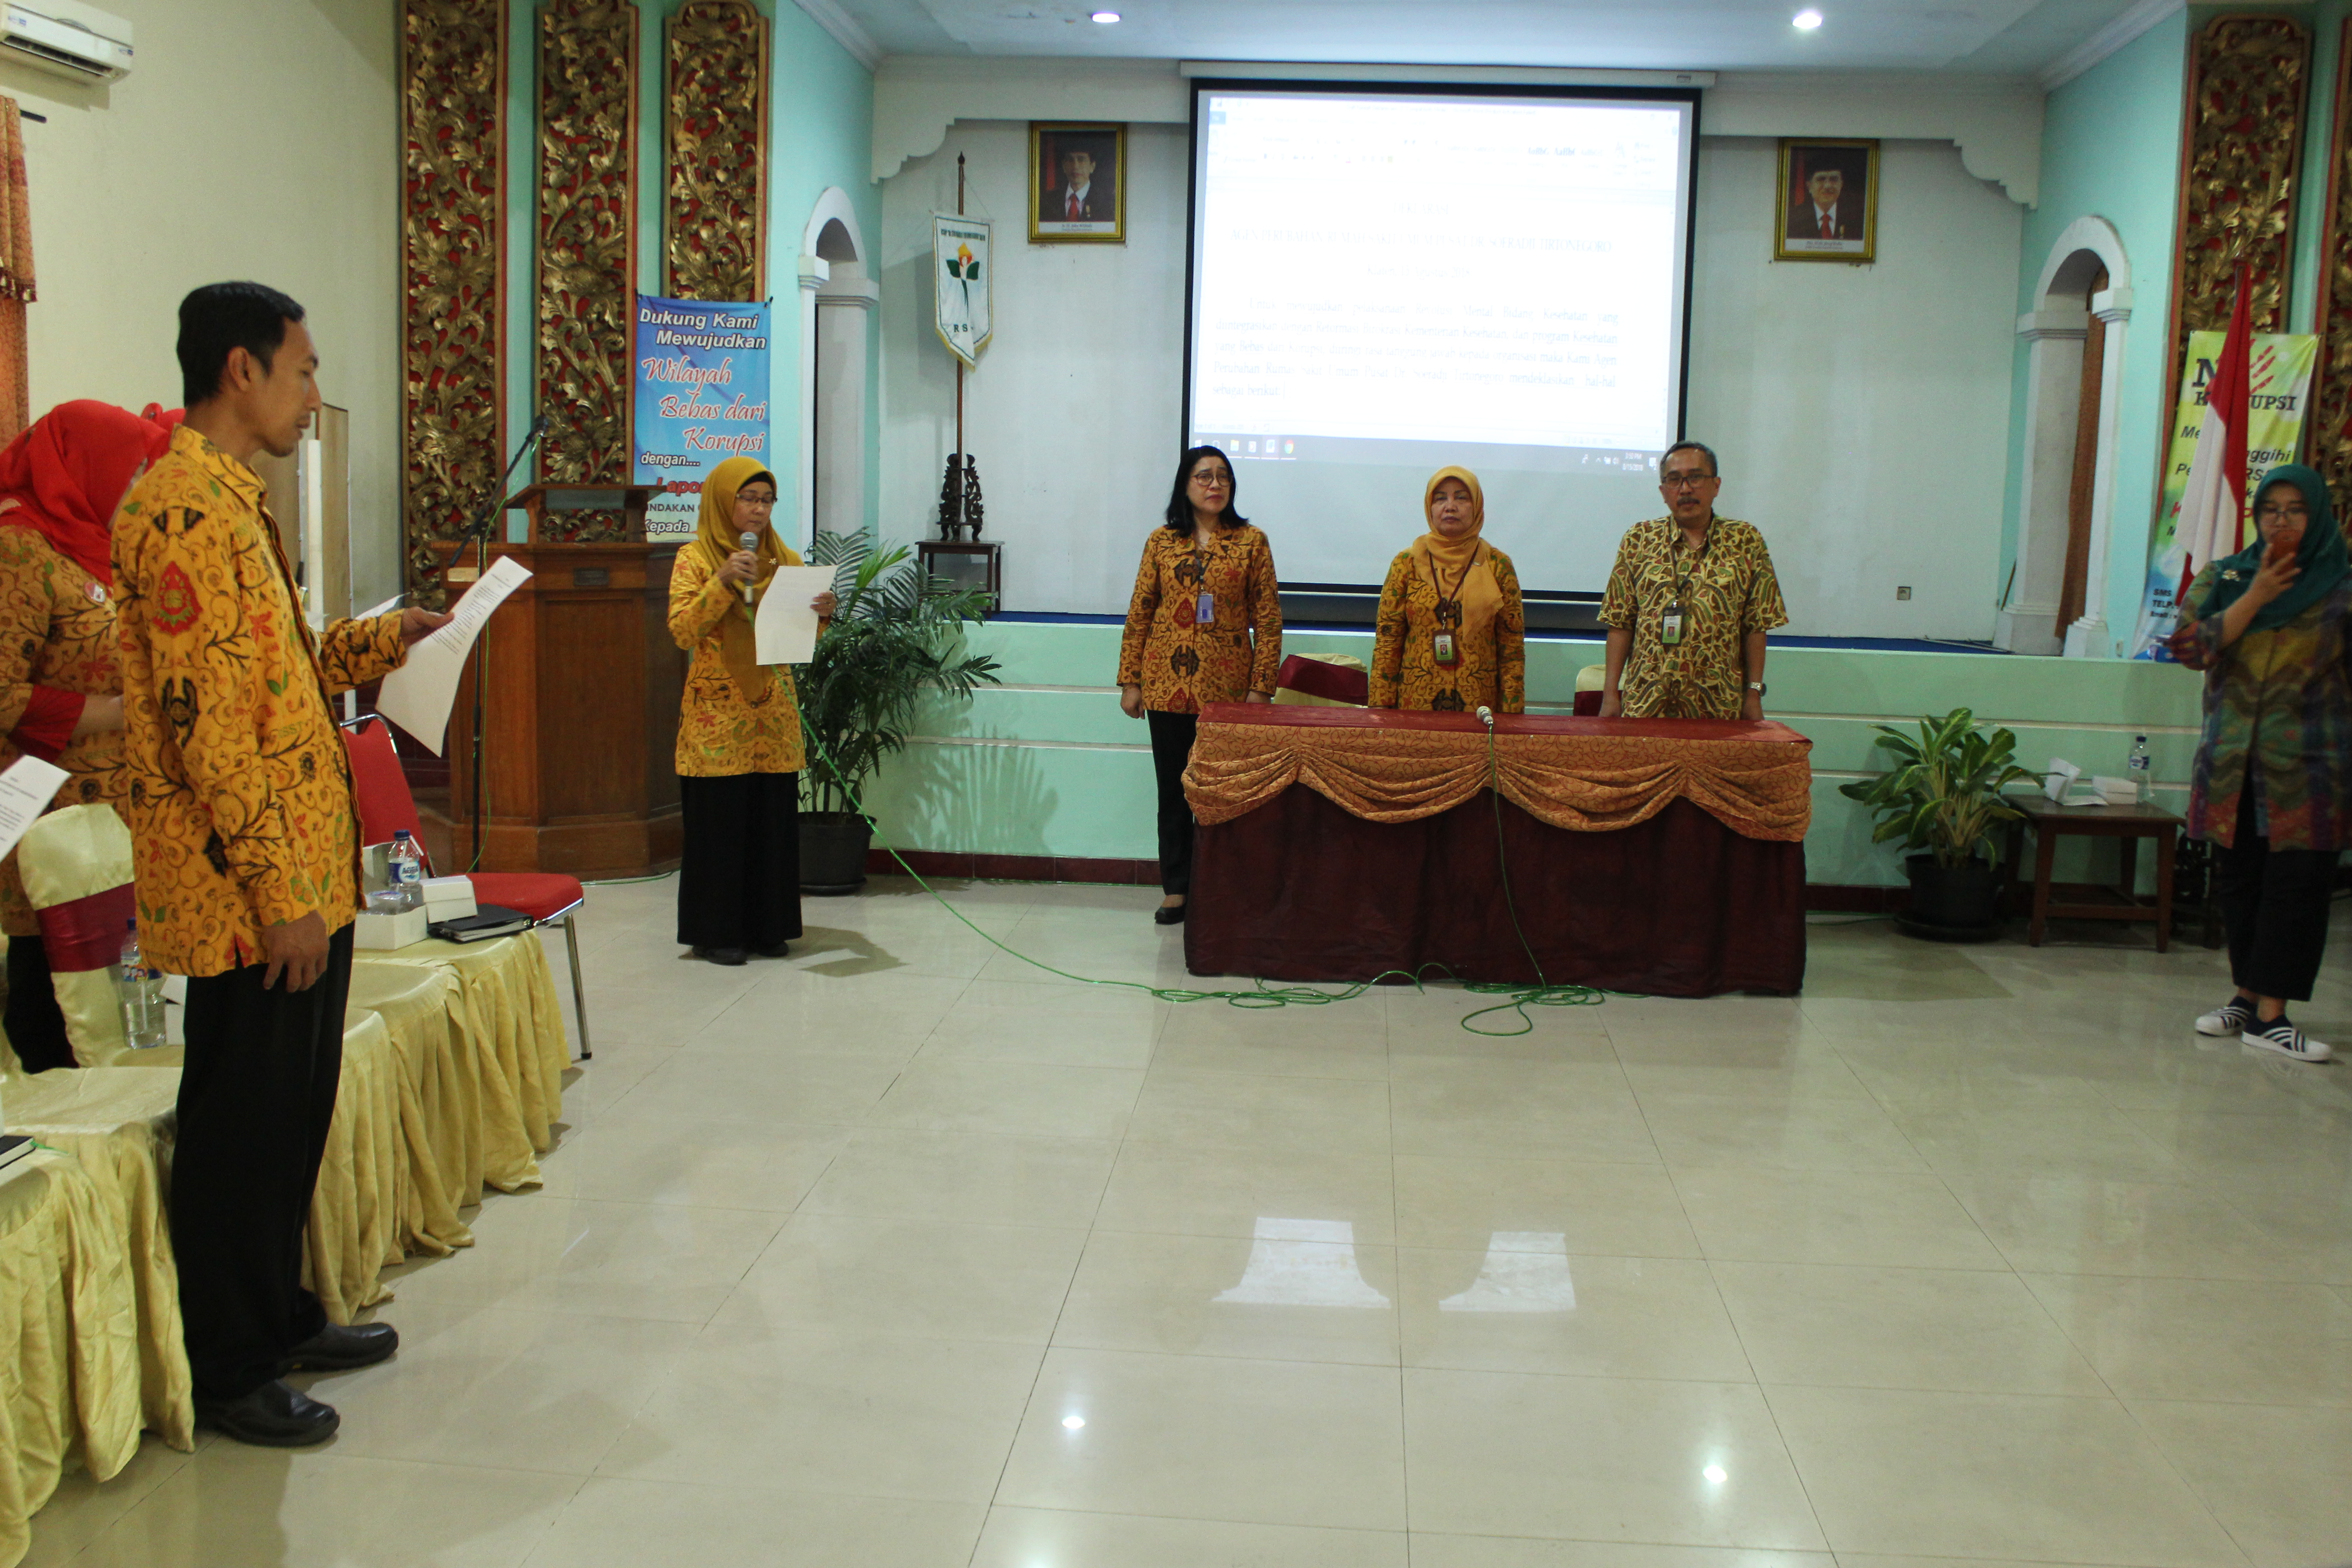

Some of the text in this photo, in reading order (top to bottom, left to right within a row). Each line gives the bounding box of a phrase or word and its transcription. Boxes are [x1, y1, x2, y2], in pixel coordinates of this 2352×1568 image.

[1394, 202, 1449, 215] DEKLARASI
[1230, 229, 1259, 240] AGEN
[1262, 230, 1323, 242] PERUBAHAN
[1328, 231, 1365, 243] RUMAH
[1368, 233, 1396, 244] SAKIT
[1400, 234, 1433, 245] UMUM
[1436, 234, 1467, 247] PUSAT
[1490, 237, 1536, 250] SOERADJI
[1540, 238, 1612, 252] TIRTONEGORO
[1367, 264, 1397, 276] Klaten,
[1414, 266, 1448, 280] Agustus
[1451, 267, 1470, 278] 2018
[640, 308, 759, 329] Dukung Kami
[1250, 297, 1619, 326] Untuk mewujudkan pelaksanaan Revolusi Mental Bidang Kesehatan yang
[656, 330, 766, 350] Mewujudkan
[1215, 318, 1618, 345] diintegrasikan dengan Reformasi Birokrasi Kementerian Kesehatan, dan program Kesehatan
[1215, 341, 1236, 355] yang
[1240, 340, 1264, 352] Bebas
[1289, 342, 1326, 357] Korupsi,
[1365, 347, 1382, 356] rasa
[1386, 346, 1426, 360] tanggung
[1430, 346, 1456, 360] jawab
[1459, 348, 1490, 363] kepada
[1493, 350, 1537, 364] organisasi
[1540, 351, 1563, 363] maka
[1567, 351, 1590, 364] Kami
[1593, 353, 1617, 368] Agen
[642, 356, 731, 395] Wilayah
[1214, 361, 1260, 374] Perubahan
[1265, 362, 1295, 374] Rumas
[1301, 363, 1322, 376] Sakit
[1328, 364, 1359, 377] Umum
[1364, 365, 1388, 377] Pusat
[1412, 368, 1447, 383] Soeradji
[1454, 368, 1504, 385] Tirtonegoro
[1509, 371, 1574, 386] mendeklasikan
[1585, 374, 1616, 387] hal-hal
[1212, 384, 1245, 399] sebagai
[2193, 392, 2297, 411] KUPSI
[659, 392, 767, 422] Bebas dari
[683, 427, 766, 457] Korupsi
